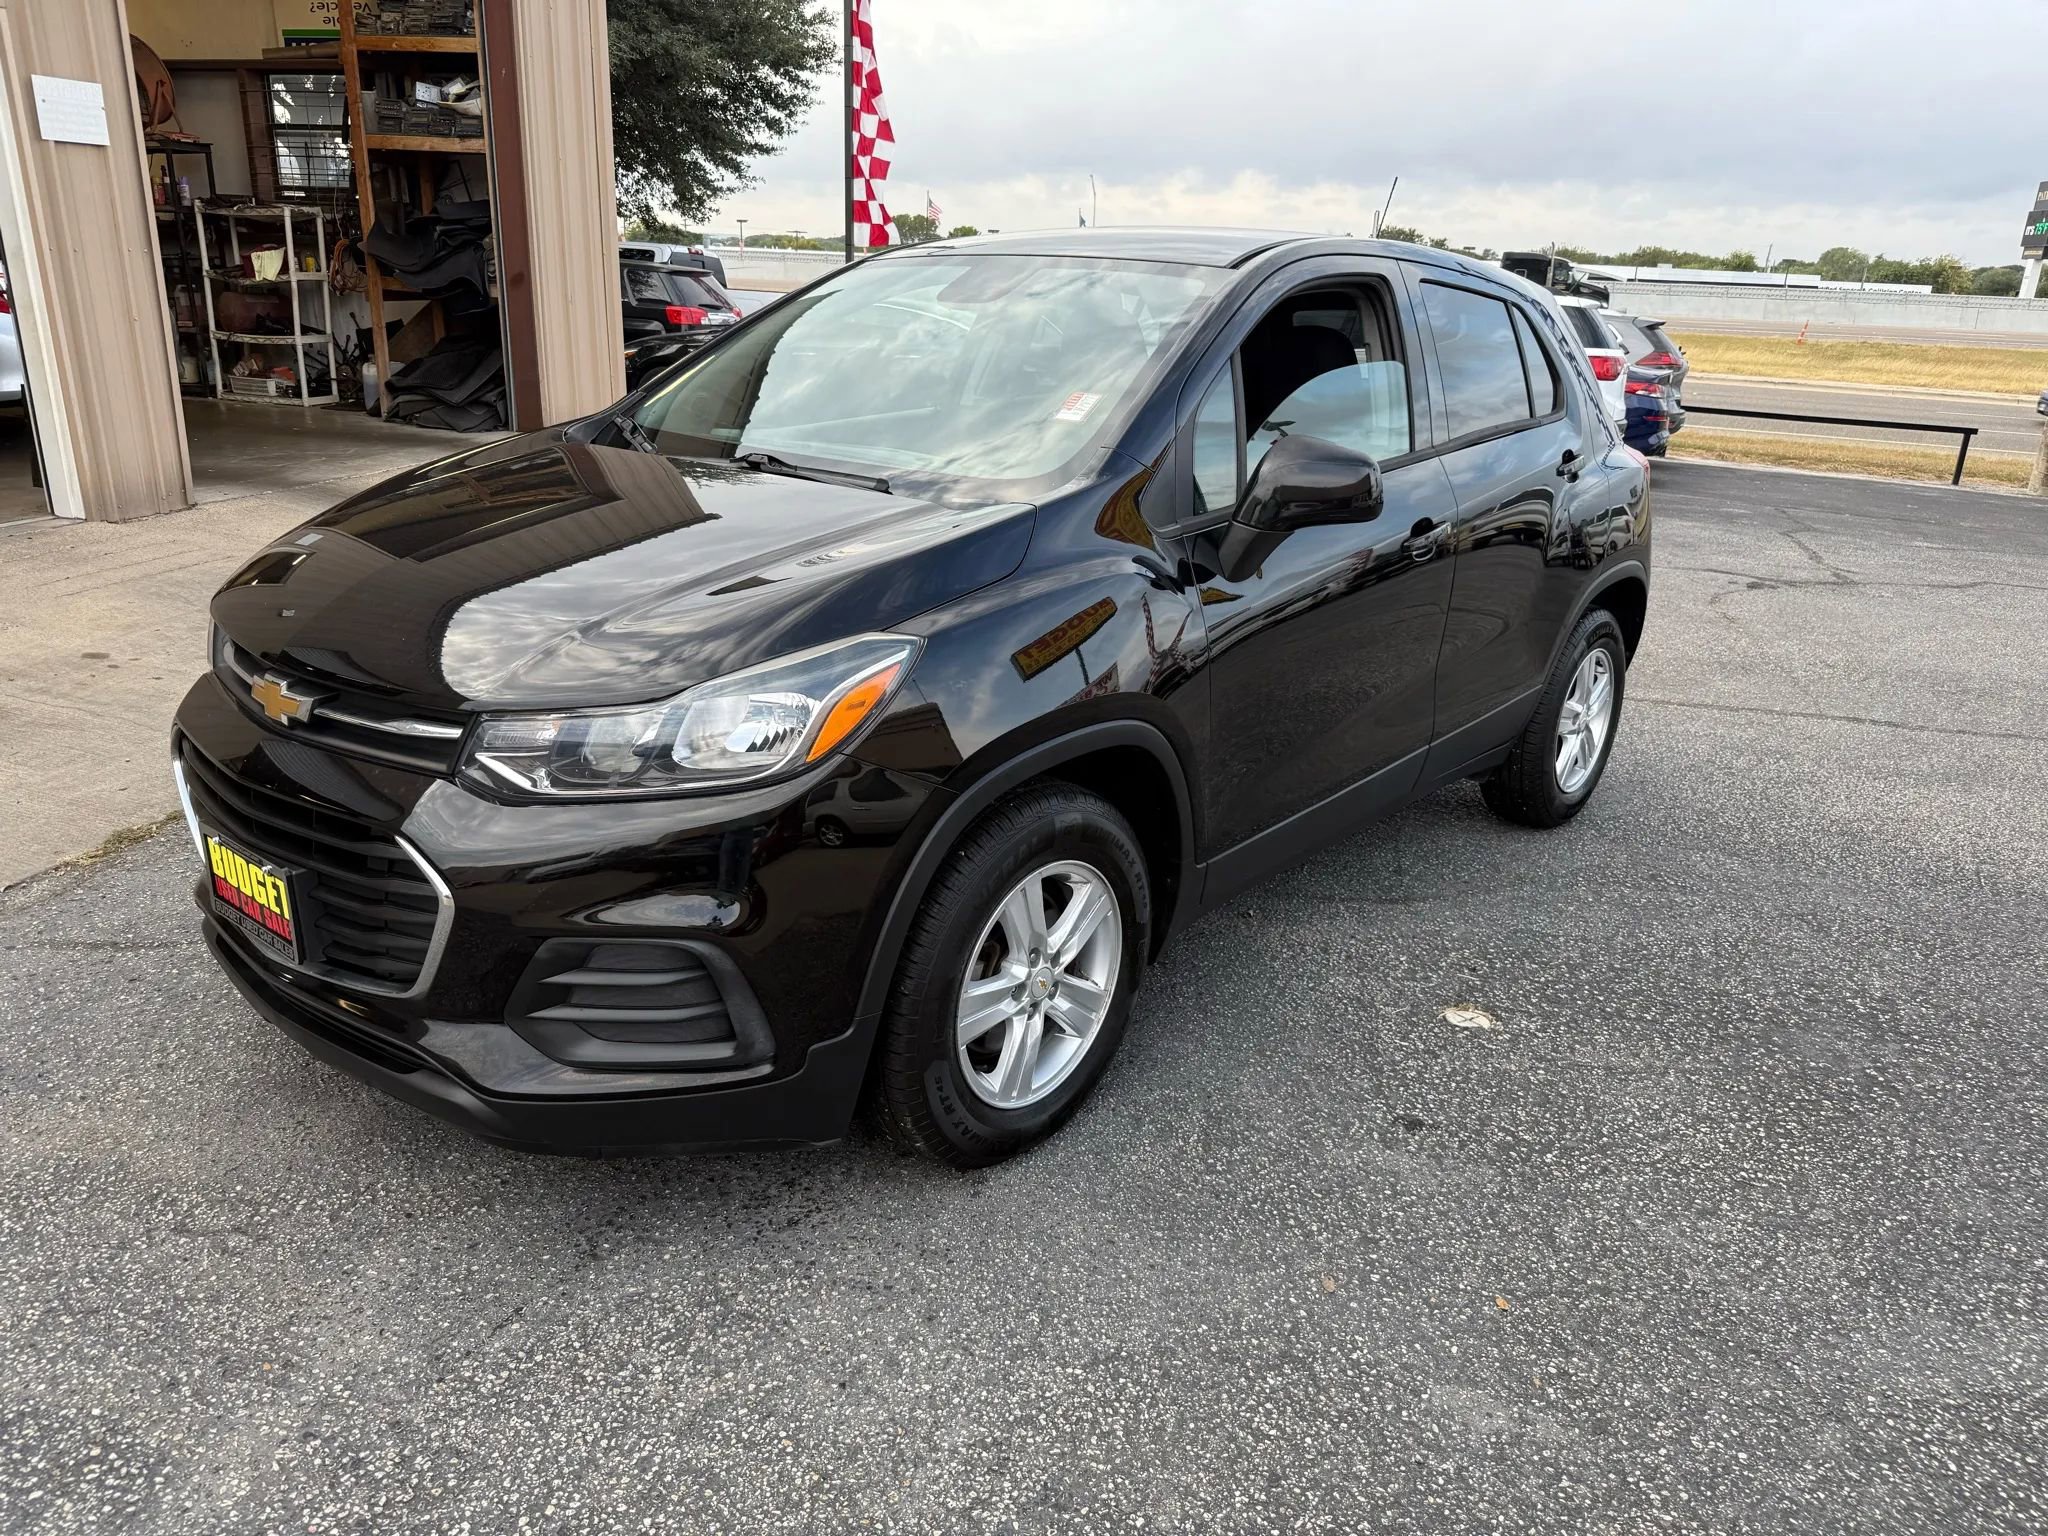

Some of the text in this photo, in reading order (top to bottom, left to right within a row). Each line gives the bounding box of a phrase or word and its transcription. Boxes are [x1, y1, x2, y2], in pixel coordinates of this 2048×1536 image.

[310, 1, 372, 13] Vecle?
[207, 836, 290, 920] BUDGET
[240, 892, 262, 922] CAR
